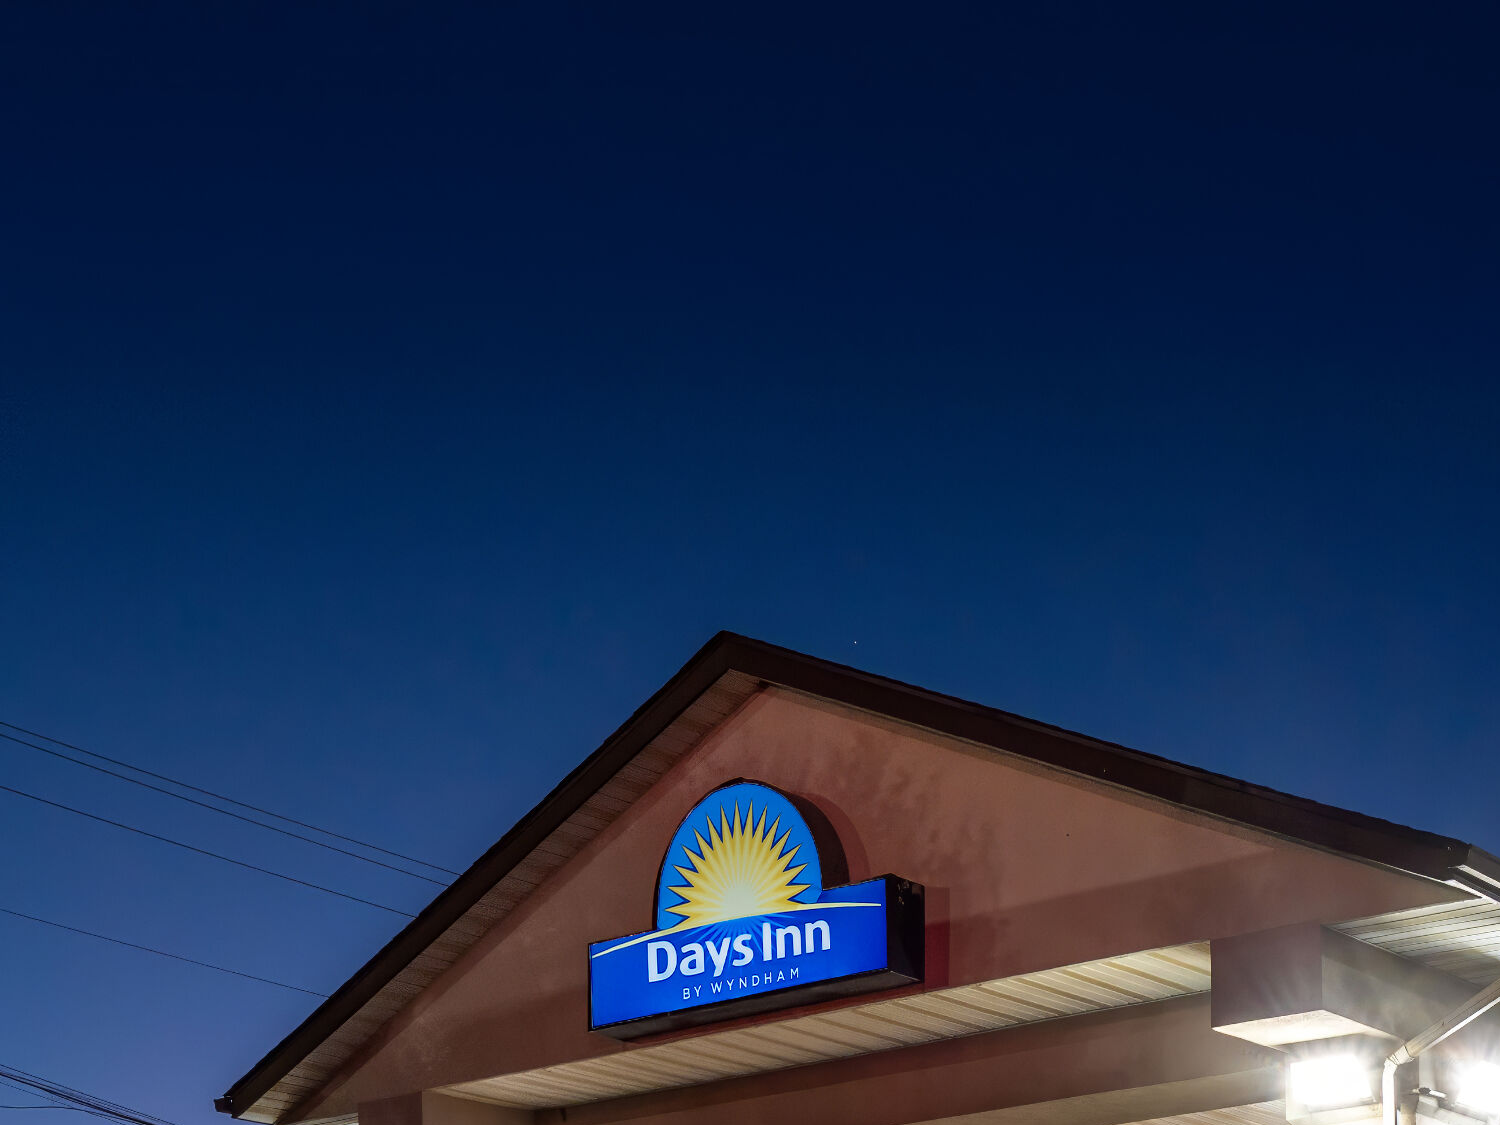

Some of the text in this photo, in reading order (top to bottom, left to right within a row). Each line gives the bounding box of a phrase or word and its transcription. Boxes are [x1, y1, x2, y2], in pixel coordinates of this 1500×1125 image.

[647, 919, 831, 983] Days Inn
[682, 967, 799, 1000] BY WYNDHAM
